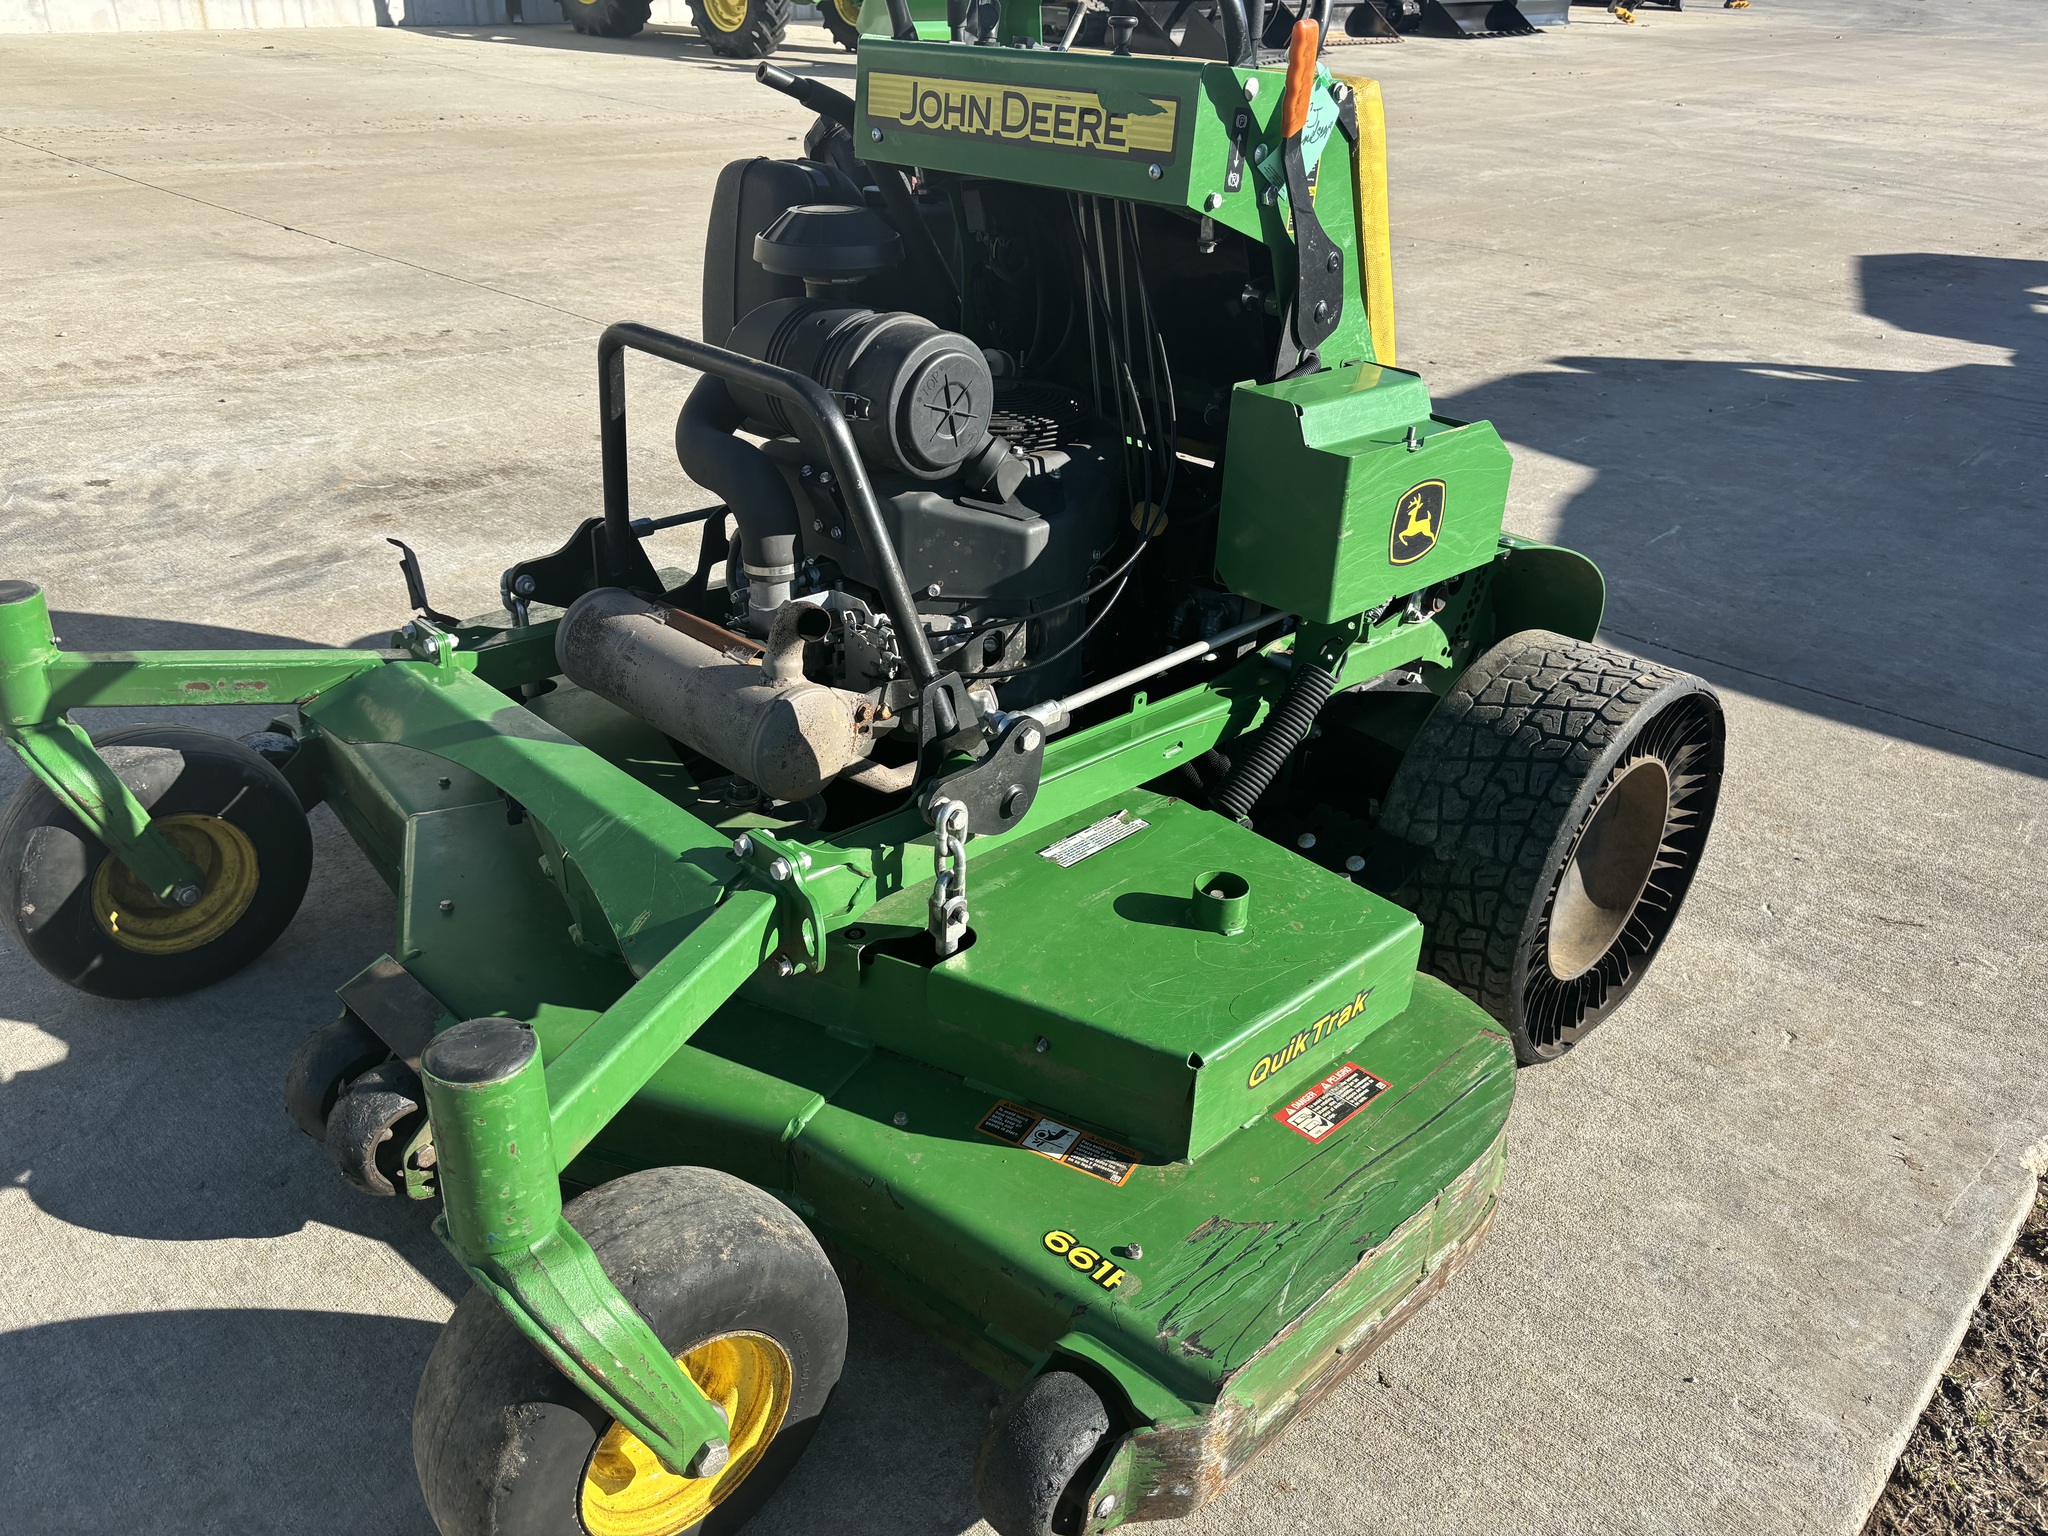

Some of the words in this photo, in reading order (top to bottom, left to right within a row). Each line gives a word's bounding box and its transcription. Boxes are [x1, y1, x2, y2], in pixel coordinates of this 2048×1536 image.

[900, 80, 993, 133] JOHN
[1001, 89, 1130, 149] DEERE
[920, 370, 939, 396] TOP
[1247, 987, 1375, 1090] QuikTrak
[1326, 1066, 1352, 1084] PELIGRO
[1291, 1091, 1317, 1110] DANGER
[1010, 1104, 1037, 1117] WARNING
[1095, 1138, 1136, 1156] ADVERTENCIA
